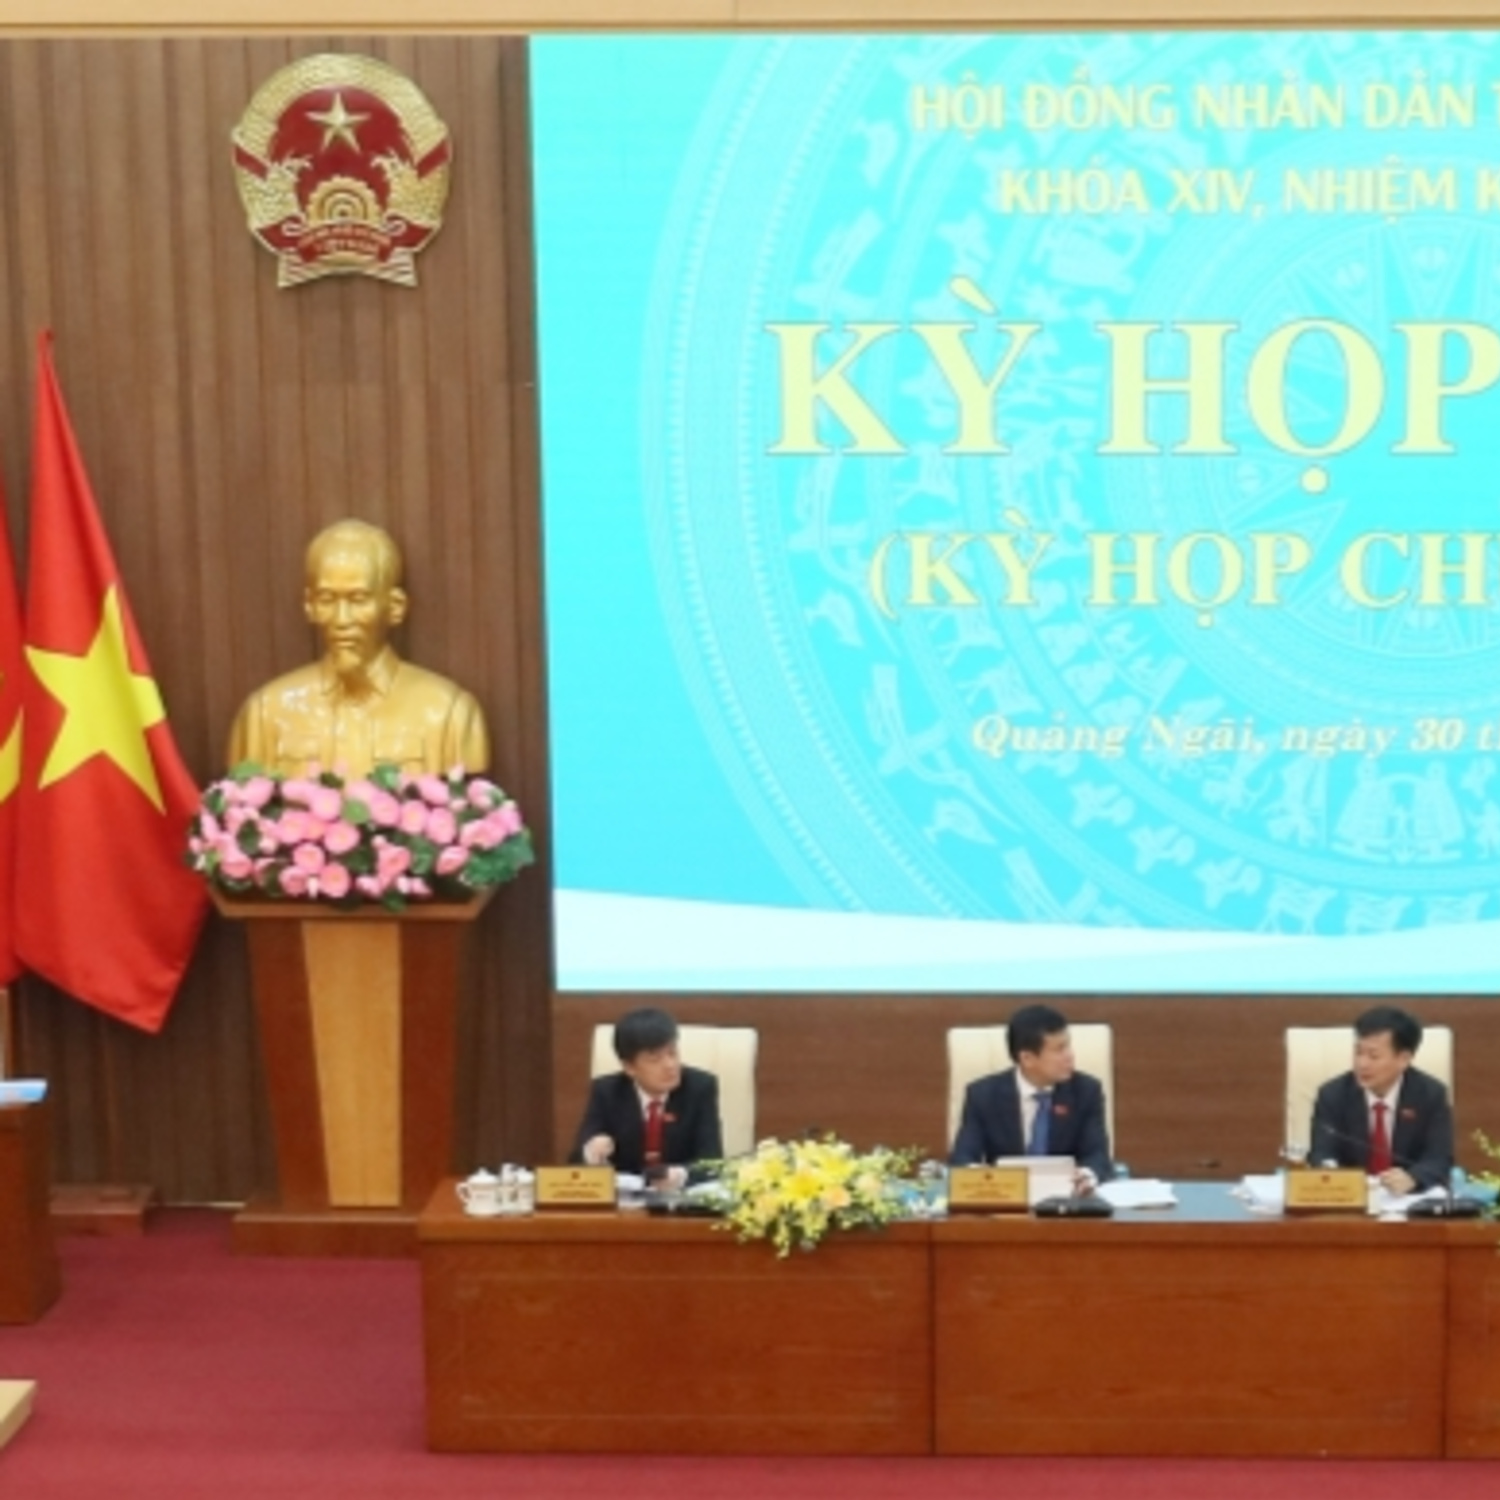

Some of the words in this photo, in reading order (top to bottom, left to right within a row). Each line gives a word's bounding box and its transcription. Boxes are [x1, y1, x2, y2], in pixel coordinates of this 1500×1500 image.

[911, 70, 1007, 141] HỘI
[1192, 68, 1345, 132] NHÂN
[1363, 67, 1477, 130] DÂN
[1166, 165, 1264, 221] XIV,
[1282, 155, 1459, 224] NHIỆM
[762, 274, 1044, 457] KỲ
[866, 506, 1057, 622] (KỲ
[1083, 530, 1313, 629] HỌP
[1281, 716, 1396, 760] ngày
[1410, 715, 1466, 752] 30
